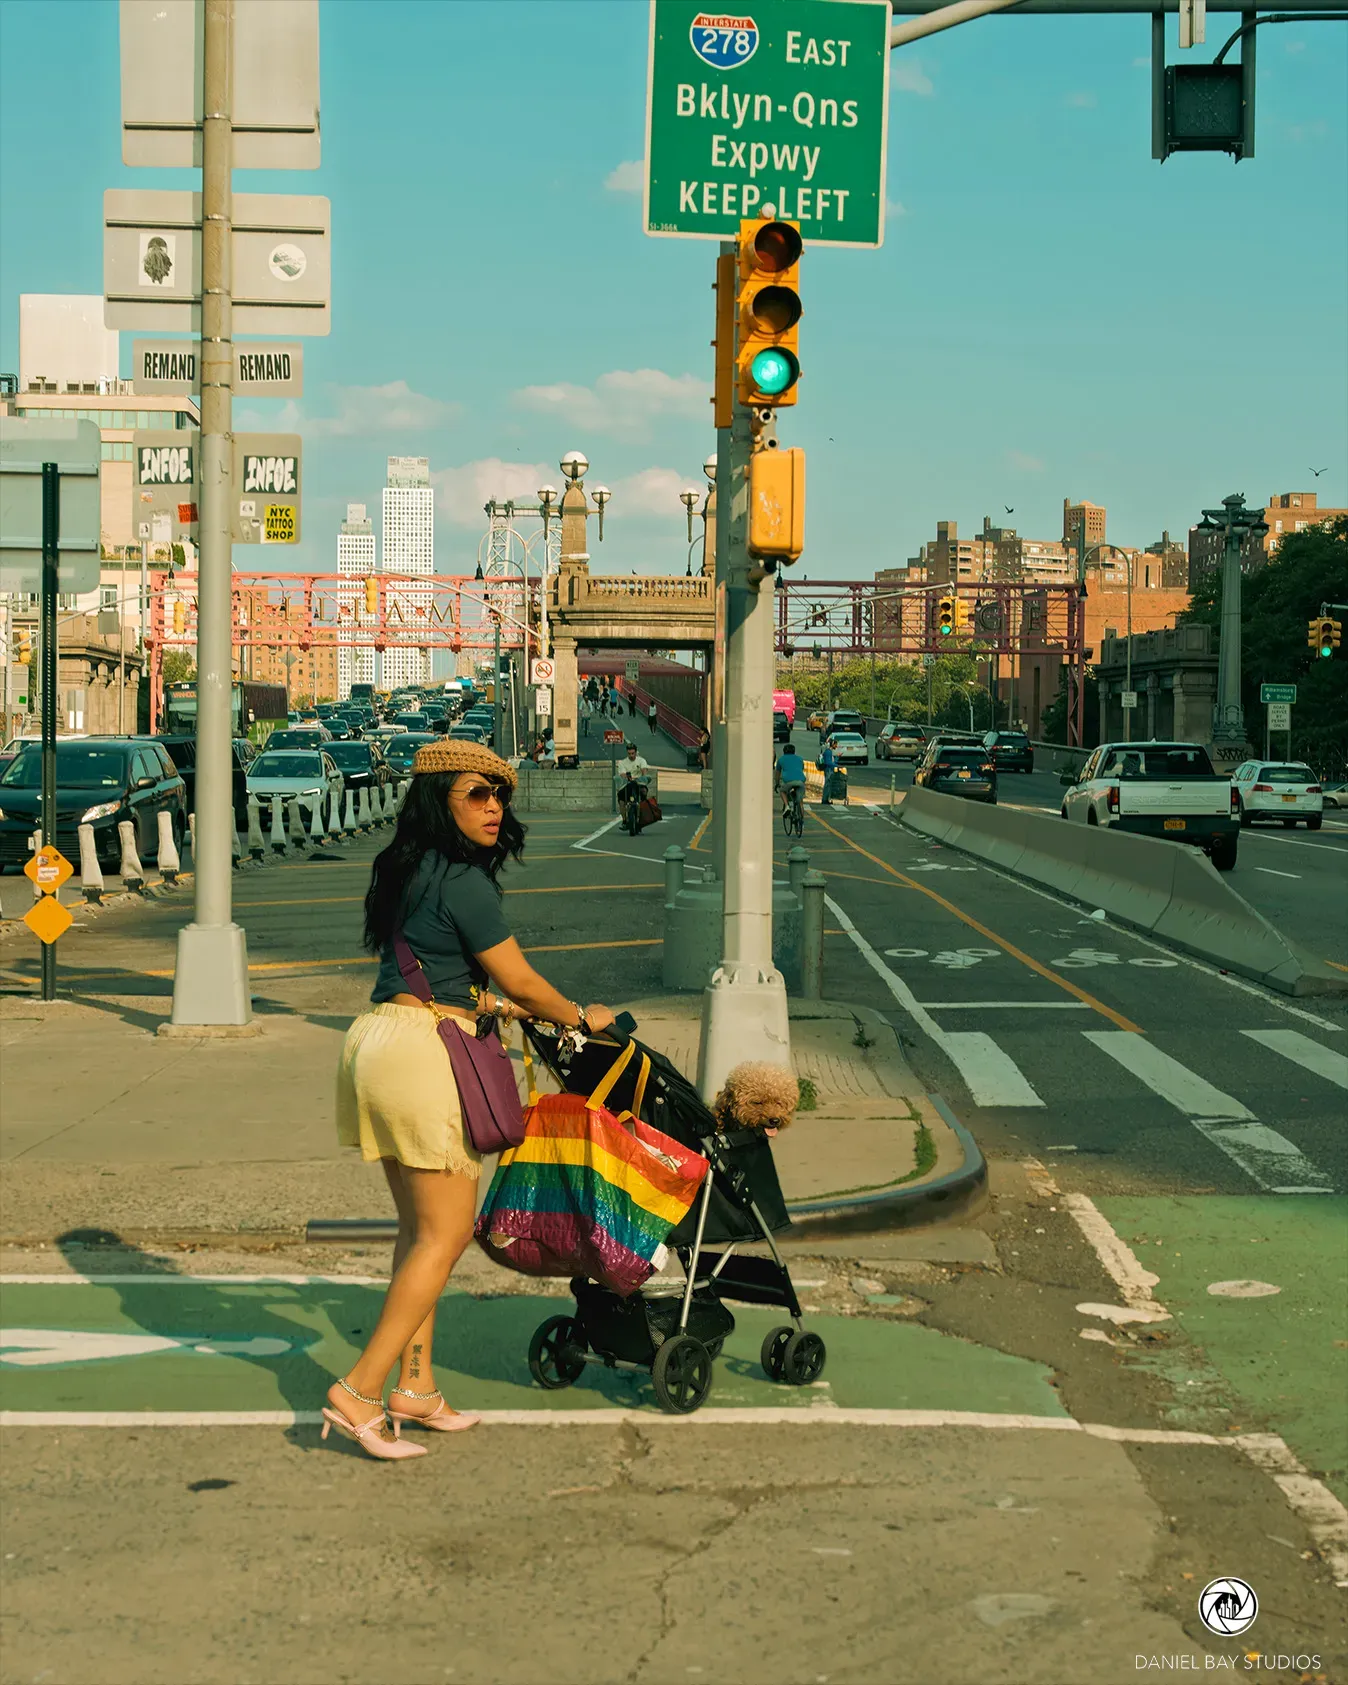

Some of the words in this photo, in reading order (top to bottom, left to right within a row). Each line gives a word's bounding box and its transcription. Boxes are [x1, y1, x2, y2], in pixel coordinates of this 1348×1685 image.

[700, 18, 748, 28] INTERSTATE
[702, 29, 750, 55] 278
[786, 30, 851, 66] EAST
[676, 83, 858, 129] Bklyn-Qns
[711, 134, 820, 181] Expwy
[679, 181, 760, 216] KEEP
[779, 186, 849, 221] LEFT
[143, 352, 196, 381] REMAND
[239, 353, 291, 381] REMAND
[140, 448, 192, 484] INFOE
[245, 456, 296, 493] INFOE
[266, 518, 294, 529] TATTOO
[270, 508, 291, 517] NYC
[266, 531, 294, 539] SHOP
[811, 600, 1041, 632] BRIGE
[539, 704, 549, 712] 15
